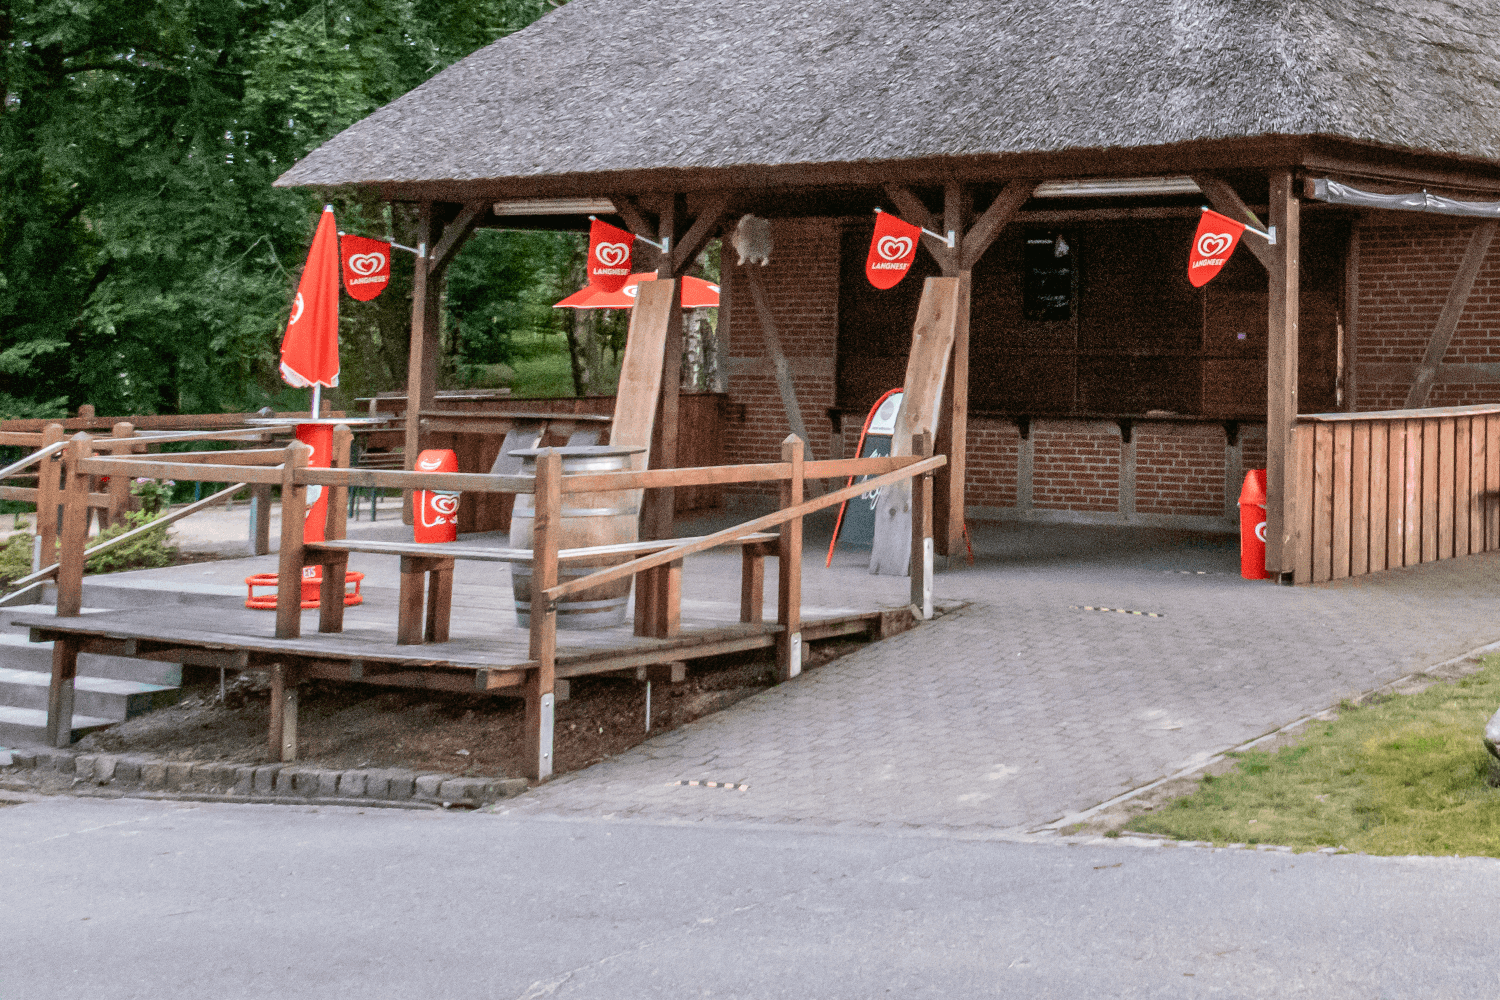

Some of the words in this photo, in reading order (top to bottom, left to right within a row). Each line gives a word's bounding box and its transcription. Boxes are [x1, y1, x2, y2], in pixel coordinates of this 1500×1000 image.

[872, 262, 906, 270] LANGNESE
[1192, 259, 1223, 268] LANGNESE
[350, 275, 386, 285] LANGNESE
